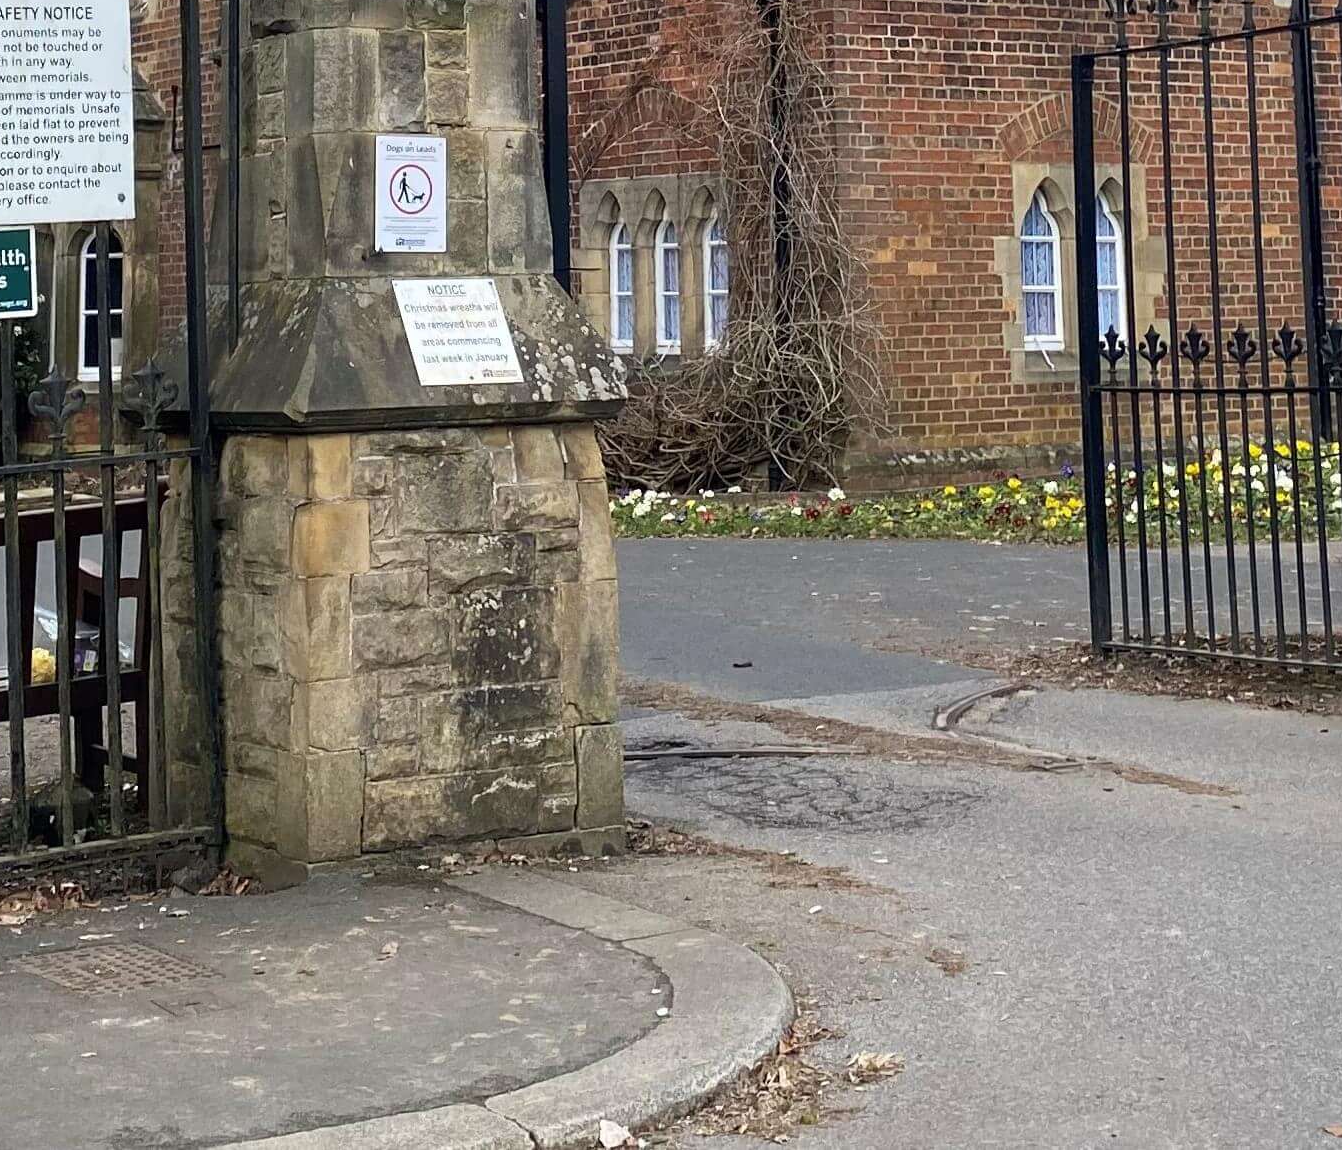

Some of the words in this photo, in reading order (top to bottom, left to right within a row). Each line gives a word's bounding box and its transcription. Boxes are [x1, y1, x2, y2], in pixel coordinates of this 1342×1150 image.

[44, 7, 93, 20] NOTICE
[62, 29, 84, 39] may
[88, 28, 101, 37] be
[4, 43, 21, 52] not
[26, 42, 38, 52] be
[43, 42, 88, 52] touched
[92, 42, 102, 51] or
[12, 57, 22, 66] in
[26, 58, 46, 69] any
[36, 91, 46, 101] is
[50, 90, 82, 100] under
[85, 91, 107, 102] way
[111, 90, 120, 99] to
[2, 105, 12, 115] of
[82, 103, 120, 114] Unsafe
[19, 119, 40, 129] laid
[65, 119, 74, 128] to
[78, 118, 120, 129] prevent
[12, 134, 29, 145] the
[33, 135, 74, 144] owners
[78, 134, 95, 143] are
[99, 133, 128, 144] being
[17, 166, 29, 175] or
[33, 166, 42, 174] to
[47, 164, 88, 176] enquire
[92, 163, 122, 173] about
[39, 179, 80, 189] contact
[84, 178, 100, 188] the
[427, 285, 466, 295] NOTICE
[405, 304, 448, 312] Christmas
